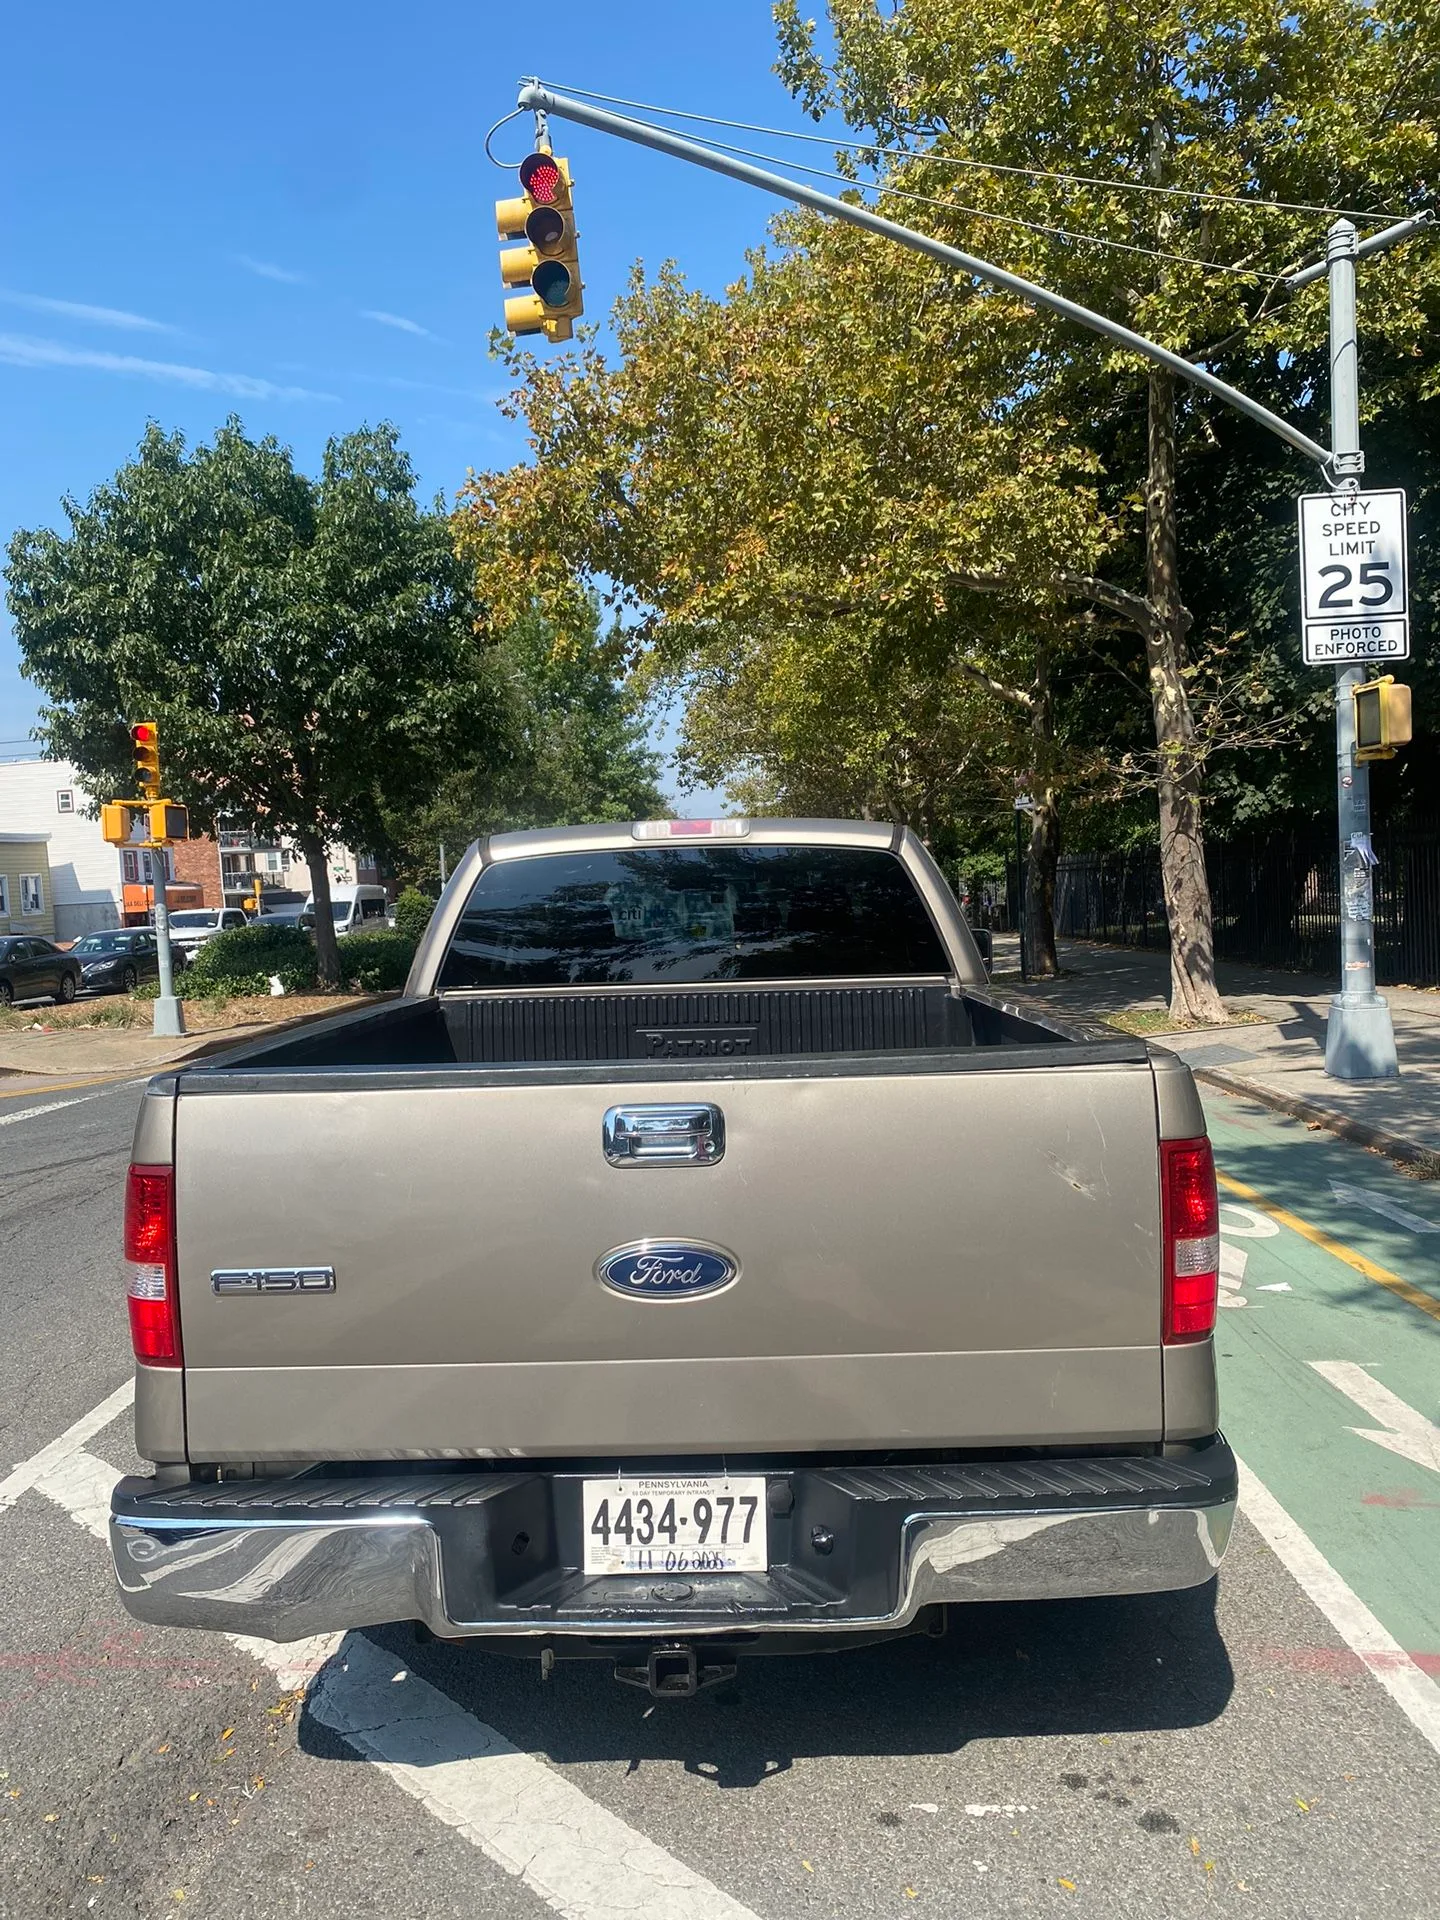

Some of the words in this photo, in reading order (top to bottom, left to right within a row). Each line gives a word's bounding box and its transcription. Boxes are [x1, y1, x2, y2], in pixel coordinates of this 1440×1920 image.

[1330, 501, 1371, 517] CITY
[1322, 521, 1381, 537] SPEED
[1329, 540, 1376, 556] LIMIT
[1318, 562, 1393, 608] 25
[1330, 626, 1381, 640] PHOTO
[1315, 640, 1397, 655] ENFORCED
[646, 1033, 751, 1056] PATRIOT
[630, 1255, 703, 1284] Ford
[638, 1480, 709, 1489] PENNSYLVANIA
